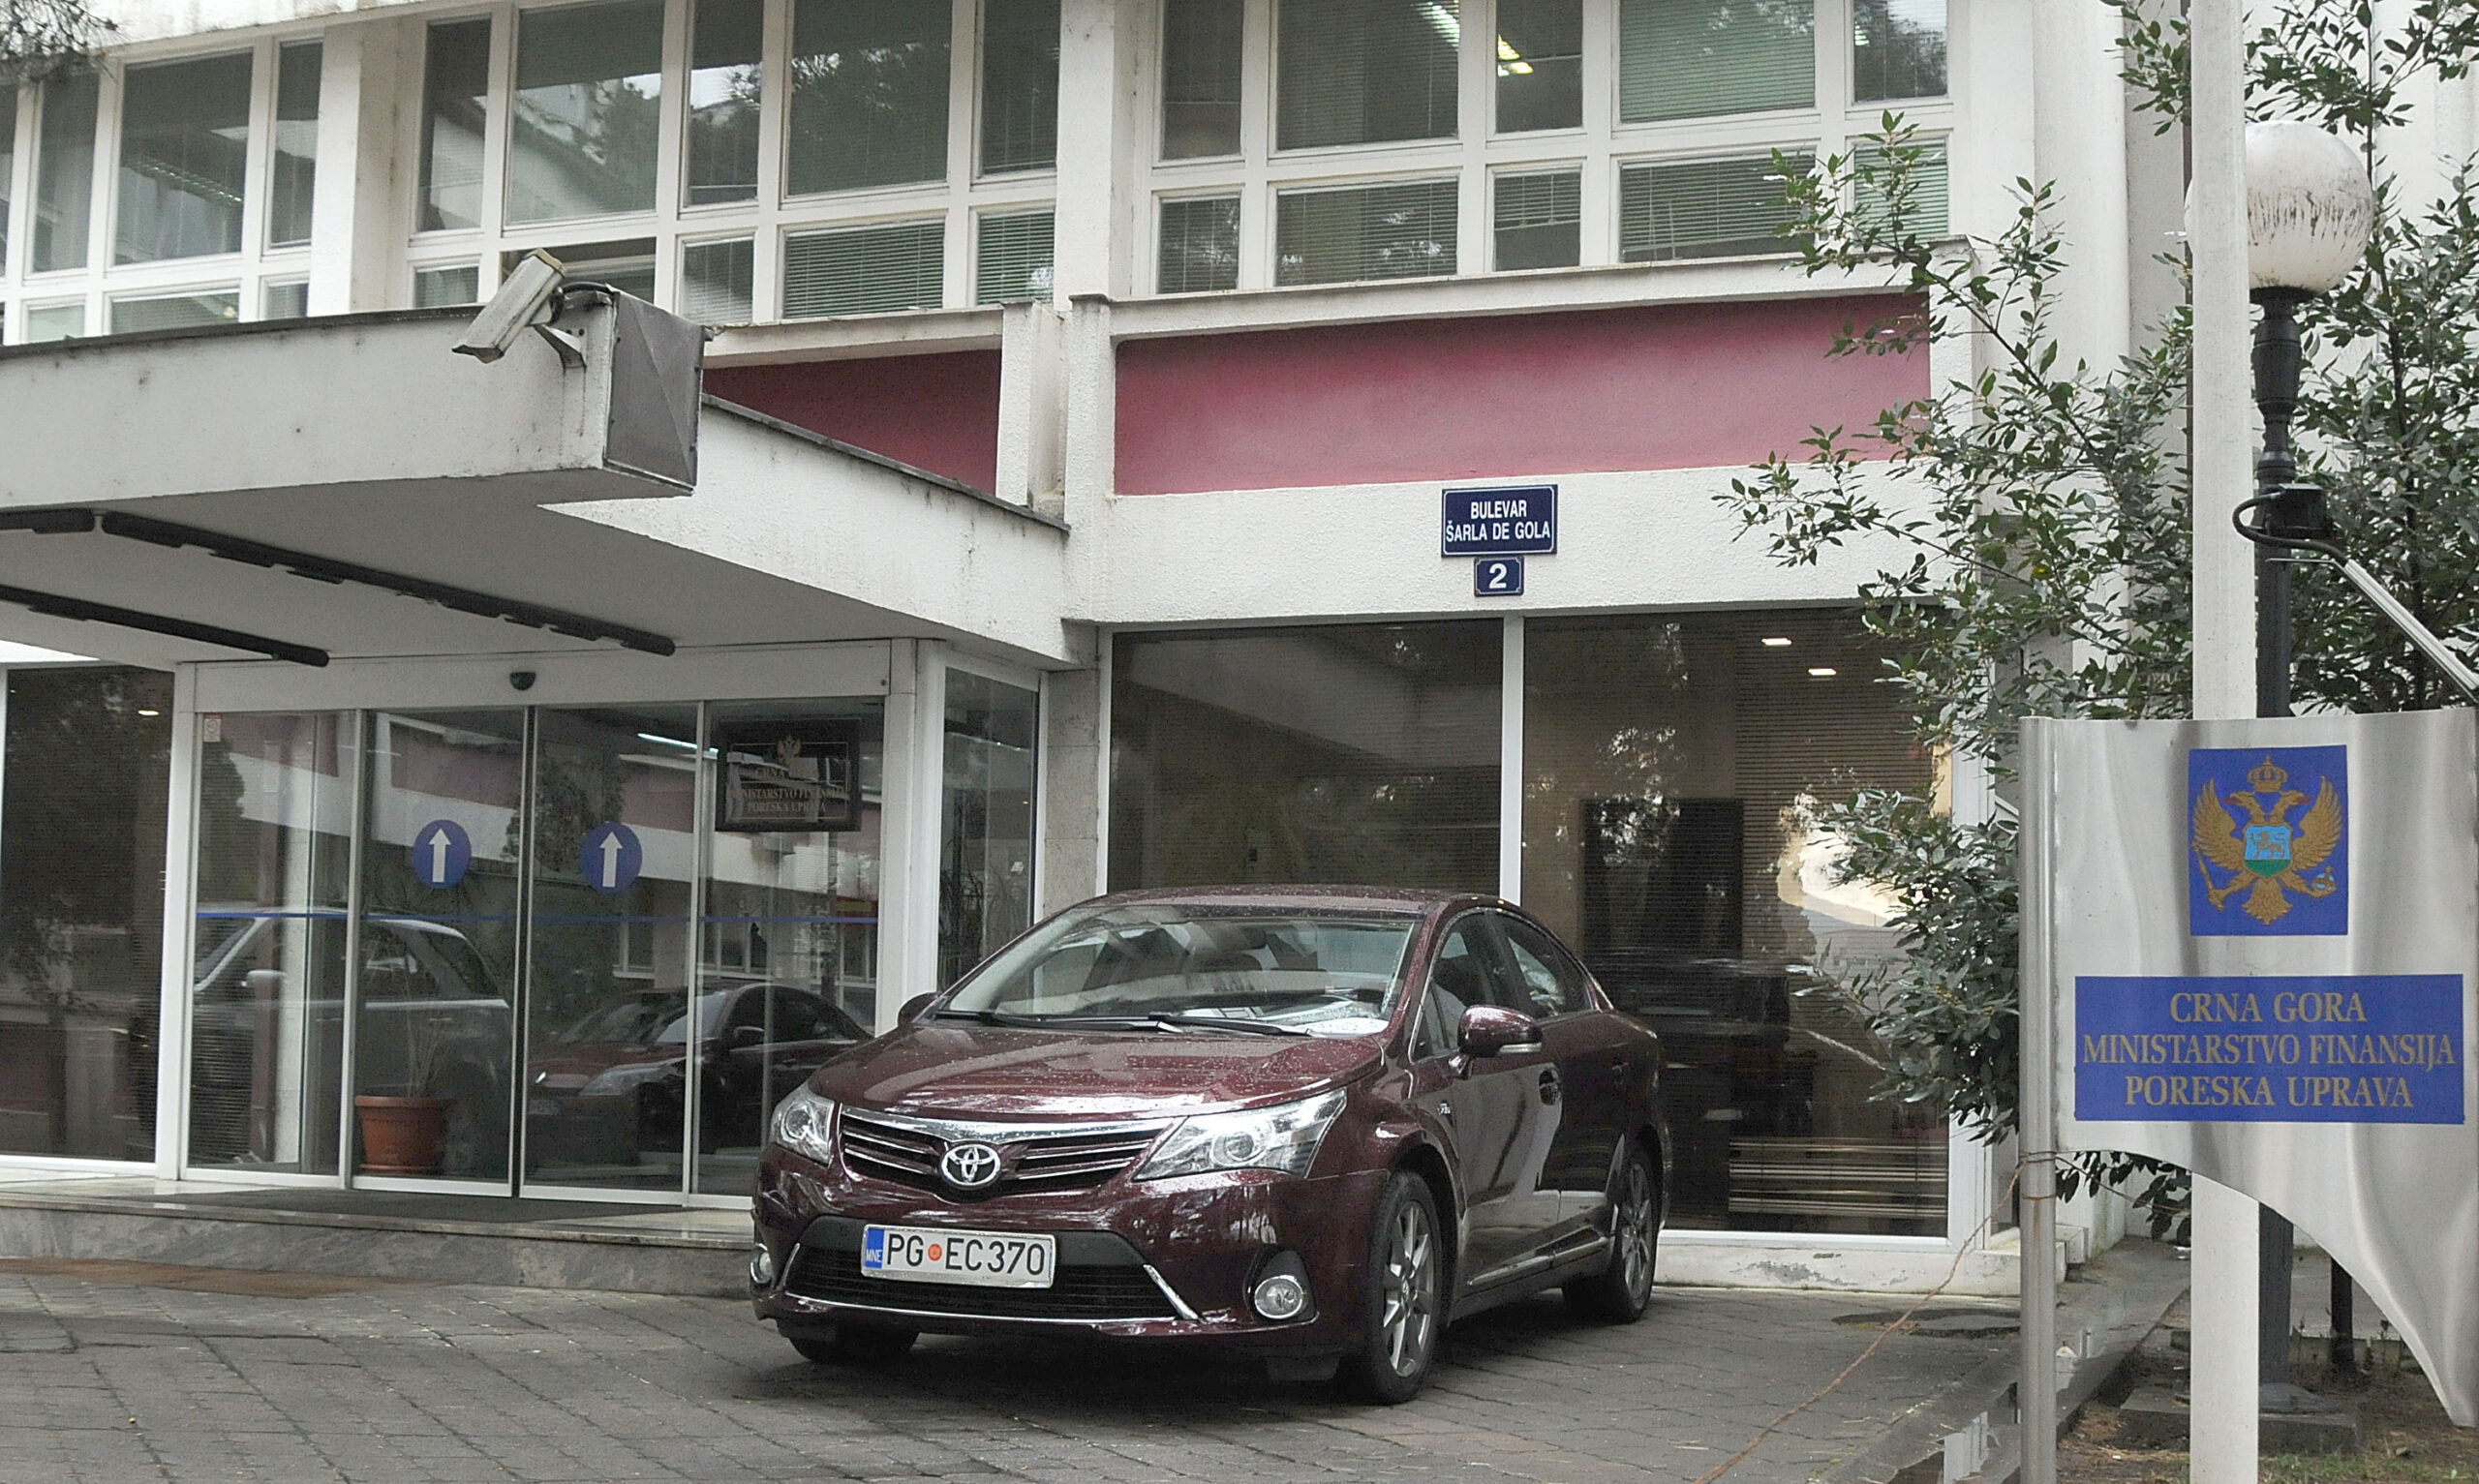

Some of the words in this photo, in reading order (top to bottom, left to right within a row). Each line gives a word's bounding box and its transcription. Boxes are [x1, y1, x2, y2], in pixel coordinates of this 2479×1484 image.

[1470, 500, 1527, 519] BULEVAR
[1446, 520, 1487, 542] ŠARLA
[1492, 522, 1510, 539] DE
[1515, 521, 1550, 539] GOLA
[1488, 562, 1508, 589] 2
[2170, 992, 2263, 1022] CRNA
[2274, 991, 2368, 1022] GORA
[2082, 1034, 2301, 1064] MINISTARSTVO
[2309, 1034, 2456, 1073] FINANSIJA
[2125, 1075, 2276, 1105] PORESKA
[2286, 1075, 2414, 1107] UPRAVA
[866, 1249, 882, 1263] MNE
[887, 1233, 924, 1266] PG
